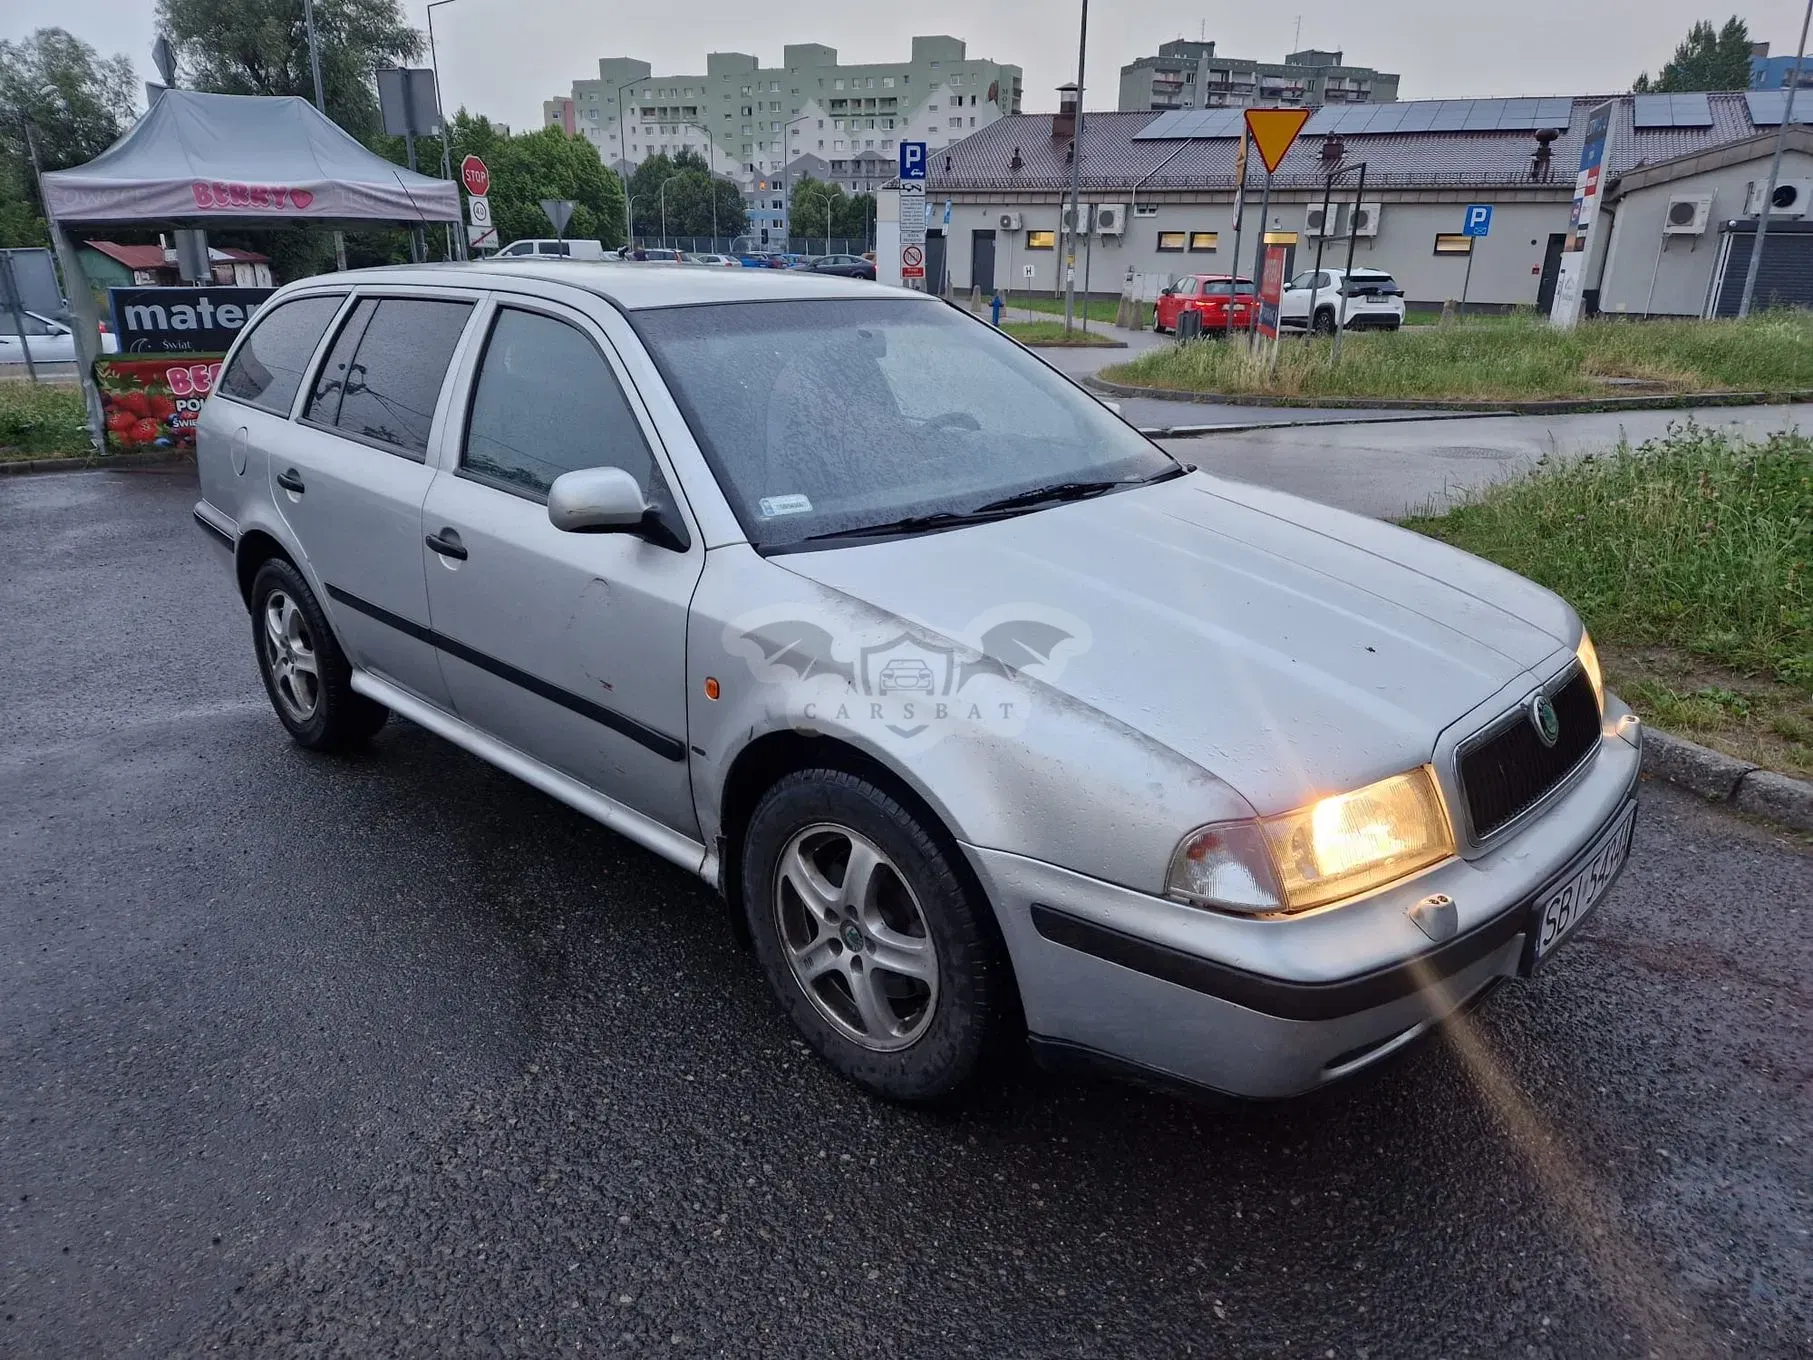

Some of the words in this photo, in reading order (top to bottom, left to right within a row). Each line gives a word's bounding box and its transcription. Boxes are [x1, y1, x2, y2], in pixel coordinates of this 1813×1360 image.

[906, 145, 921, 168] P
[465, 169, 486, 183] STOP
[191, 182, 288, 209] BERRY
[1470, 208, 1487, 228] P
[1026, 266, 1032, 276] H
[162, 338, 193, 349] Świat
[1542, 873, 1583, 946] SBI
